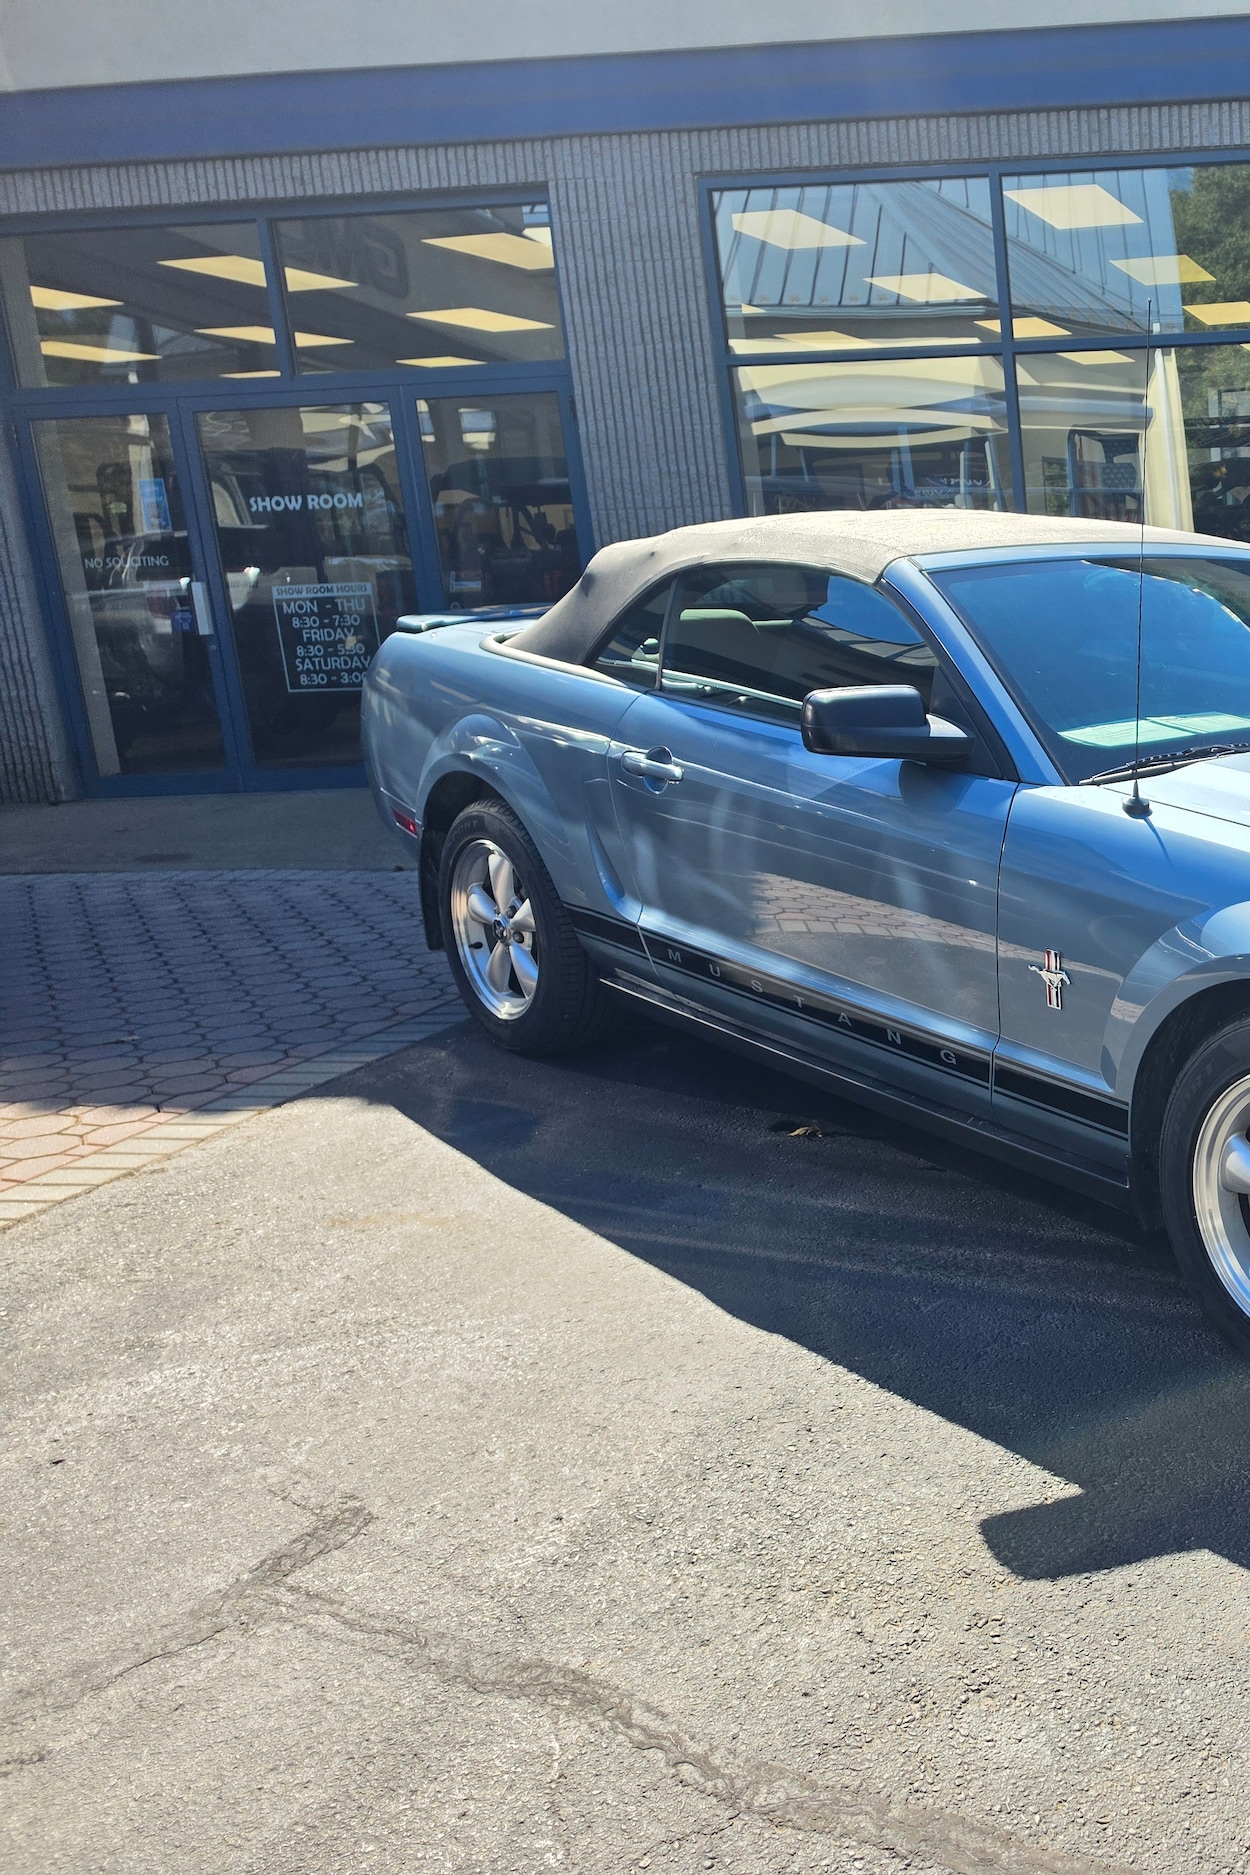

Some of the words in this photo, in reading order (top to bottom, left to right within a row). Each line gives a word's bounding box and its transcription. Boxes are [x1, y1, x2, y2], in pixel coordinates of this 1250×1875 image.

[249, 495, 302, 512] SHOW
[306, 492, 363, 510] ROOM
[85, 557, 103, 569] NO
[276, 586, 303, 596] SHOW
[306, 585, 334, 595] ROOM
[336, 583, 368, 594] HOURS
[282, 600, 318, 614] MON
[335, 598, 365, 612] THU
[292, 616, 320, 628] 8:30
[332, 614, 360, 626] 7:30
[302, 627, 355, 642] FRIDAY
[296, 645, 324, 657] 8:30
[295, 655, 371, 671] SATURDAY
[300, 673, 328, 685] 8:30
[667, 948, 958, 1066] MUSTANG
